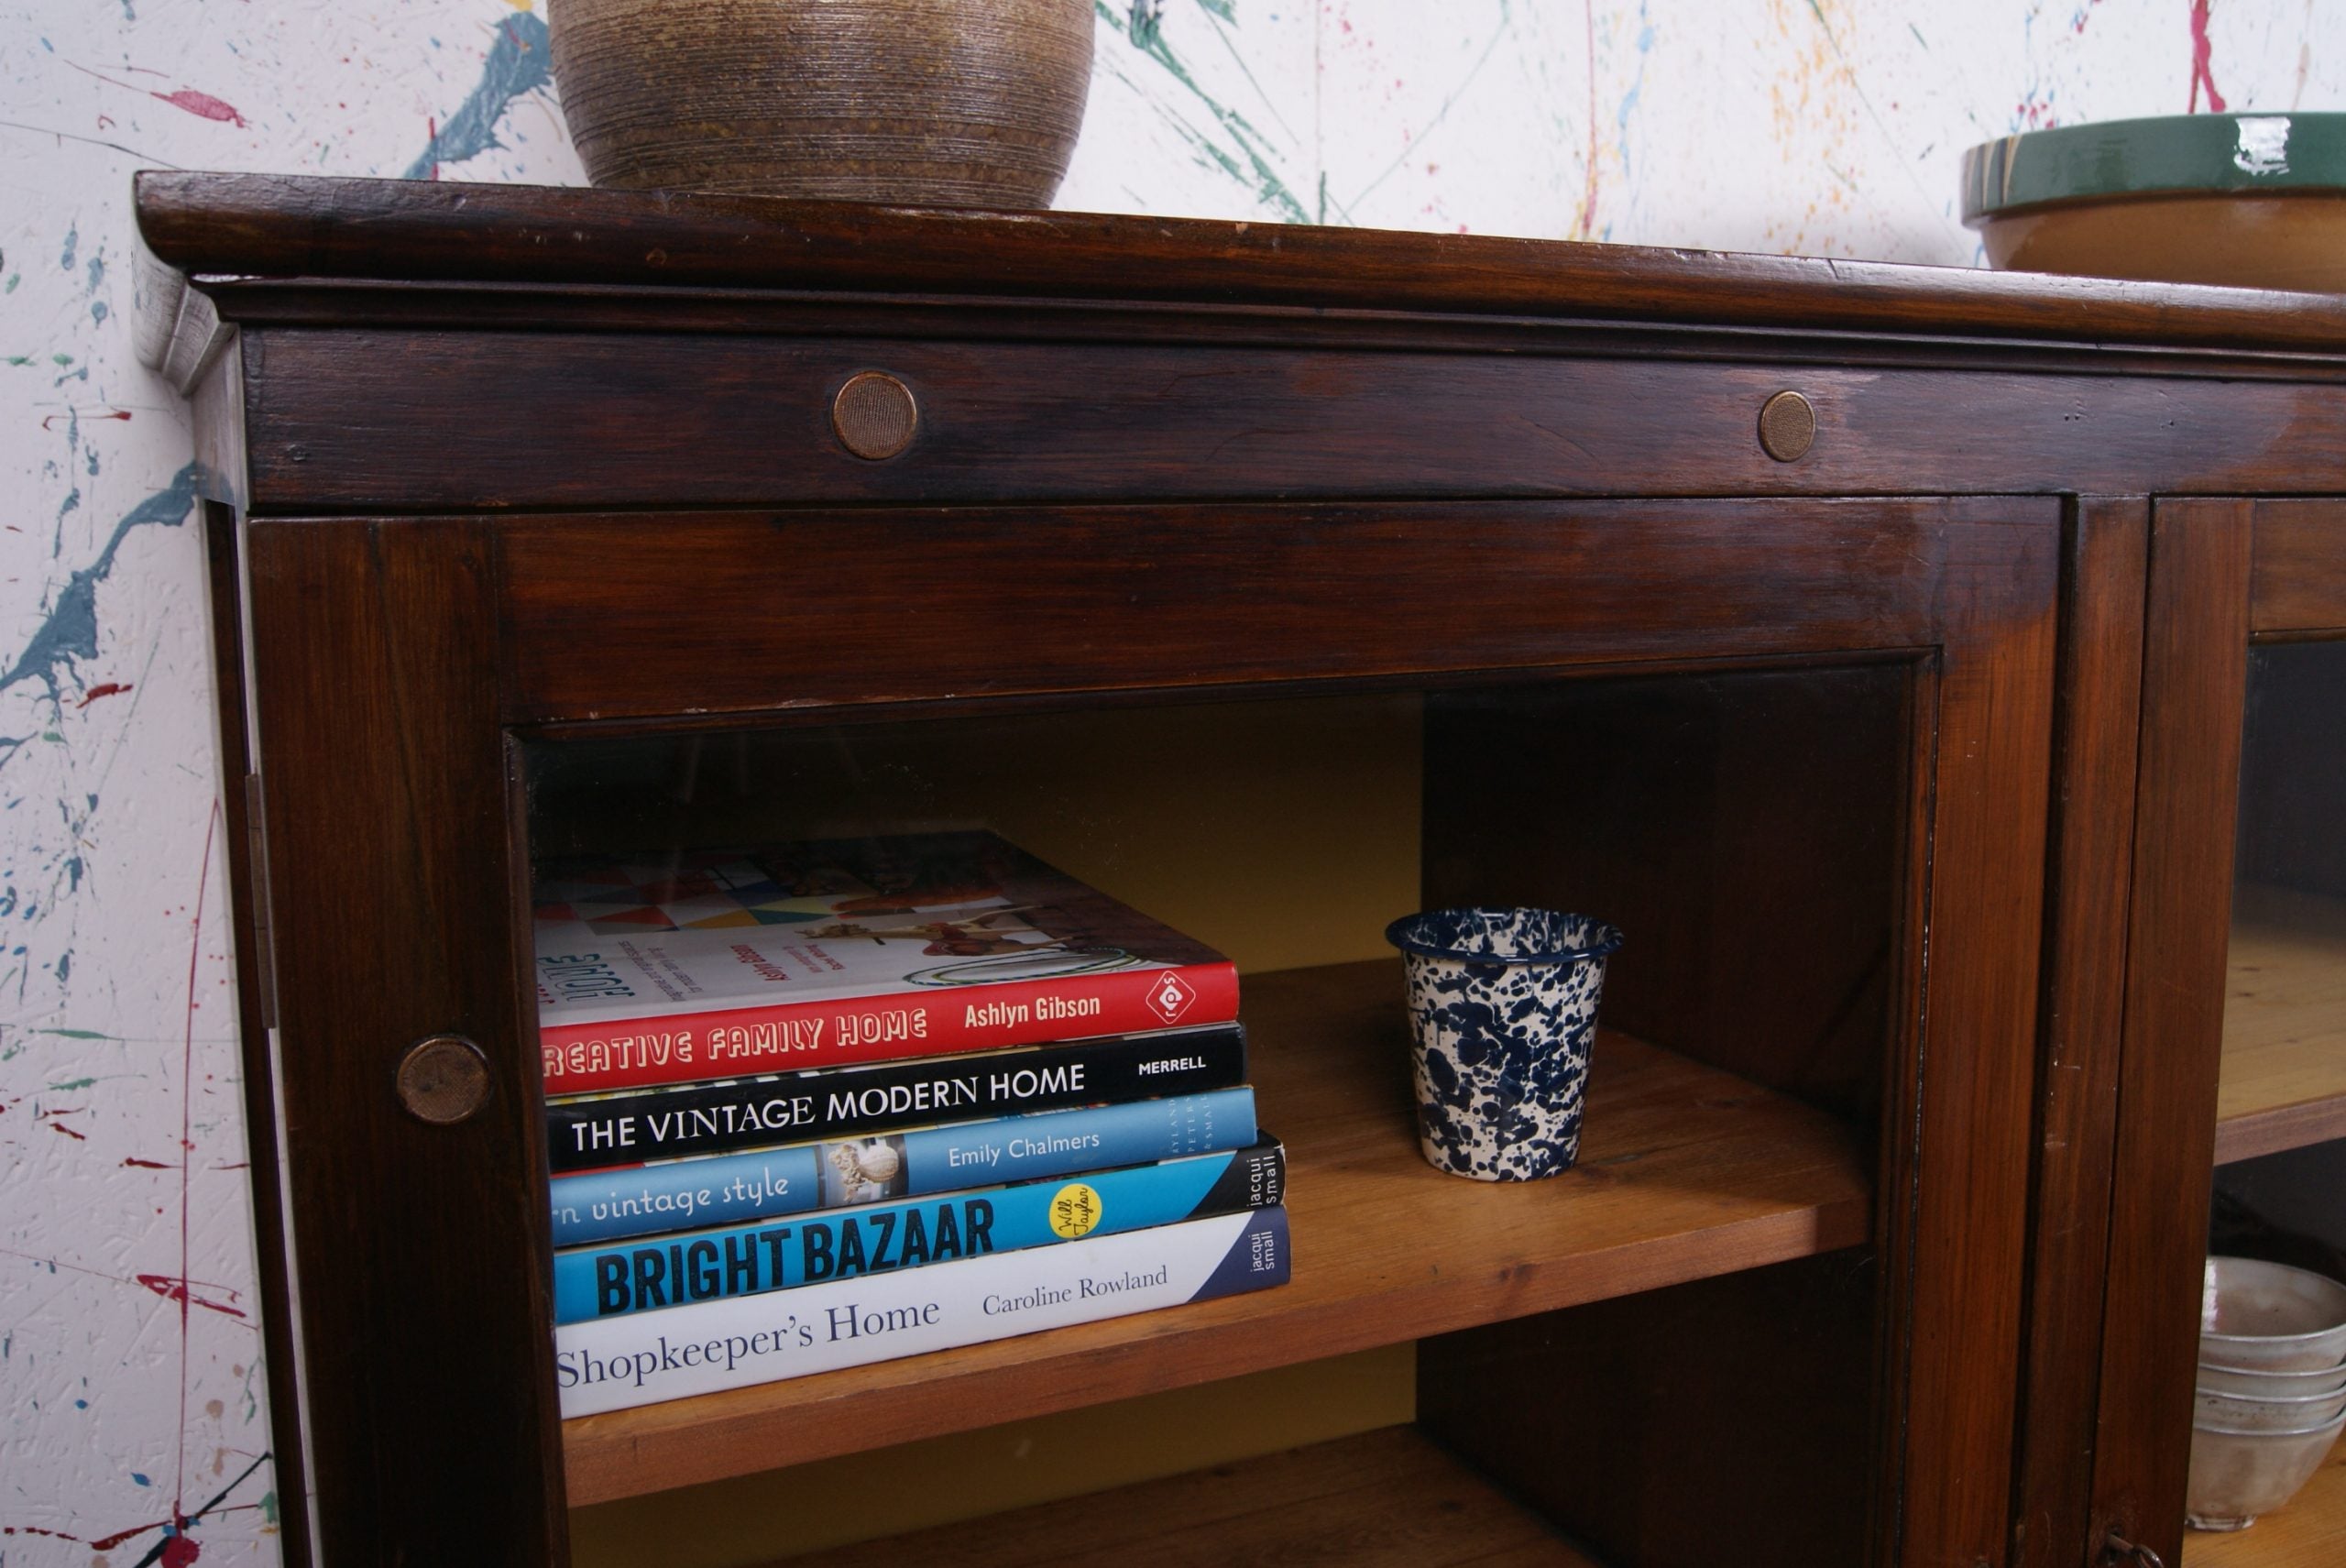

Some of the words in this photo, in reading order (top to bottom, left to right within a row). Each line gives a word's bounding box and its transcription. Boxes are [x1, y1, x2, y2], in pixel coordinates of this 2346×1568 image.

[707, 1018, 824, 1059] FAMILY
[836, 1008, 927, 1047] HOME
[965, 1002, 1027, 1028] Ashlyn
[1036, 996, 1101, 1021] Gibson
[1138, 1056, 1206, 1076] MERRELL
[572, 1116, 636, 1151] THE
[647, 1096, 817, 1143] VINTAGE
[827, 1076, 979, 1121] MODERN
[991, 1064, 1085, 1101] HOME
[948, 1146, 1001, 1168] Emily
[1008, 1134, 1101, 1158] Chalmers
[592, 1188, 711, 1221] vintage
[723, 1167, 789, 1207] style
[1246, 1157, 1264, 1207] jacqui
[1263, 1155, 1277, 1204] small
[1058, 1199, 1072, 1232] Will
[1073, 1188, 1093, 1235] Taylor
[596, 1228, 791, 1314] BRIGHT
[803, 1199, 994, 1282] BAZAAR
[1248, 1233, 1265, 1273] jacqui
[1261, 1230, 1275, 1270] small
[983, 1285, 1071, 1317] Caroline
[1080, 1266, 1168, 1299] Rowland
[557, 1316, 814, 1388] Shopkeeper's
[824, 1302, 940, 1343] Home
